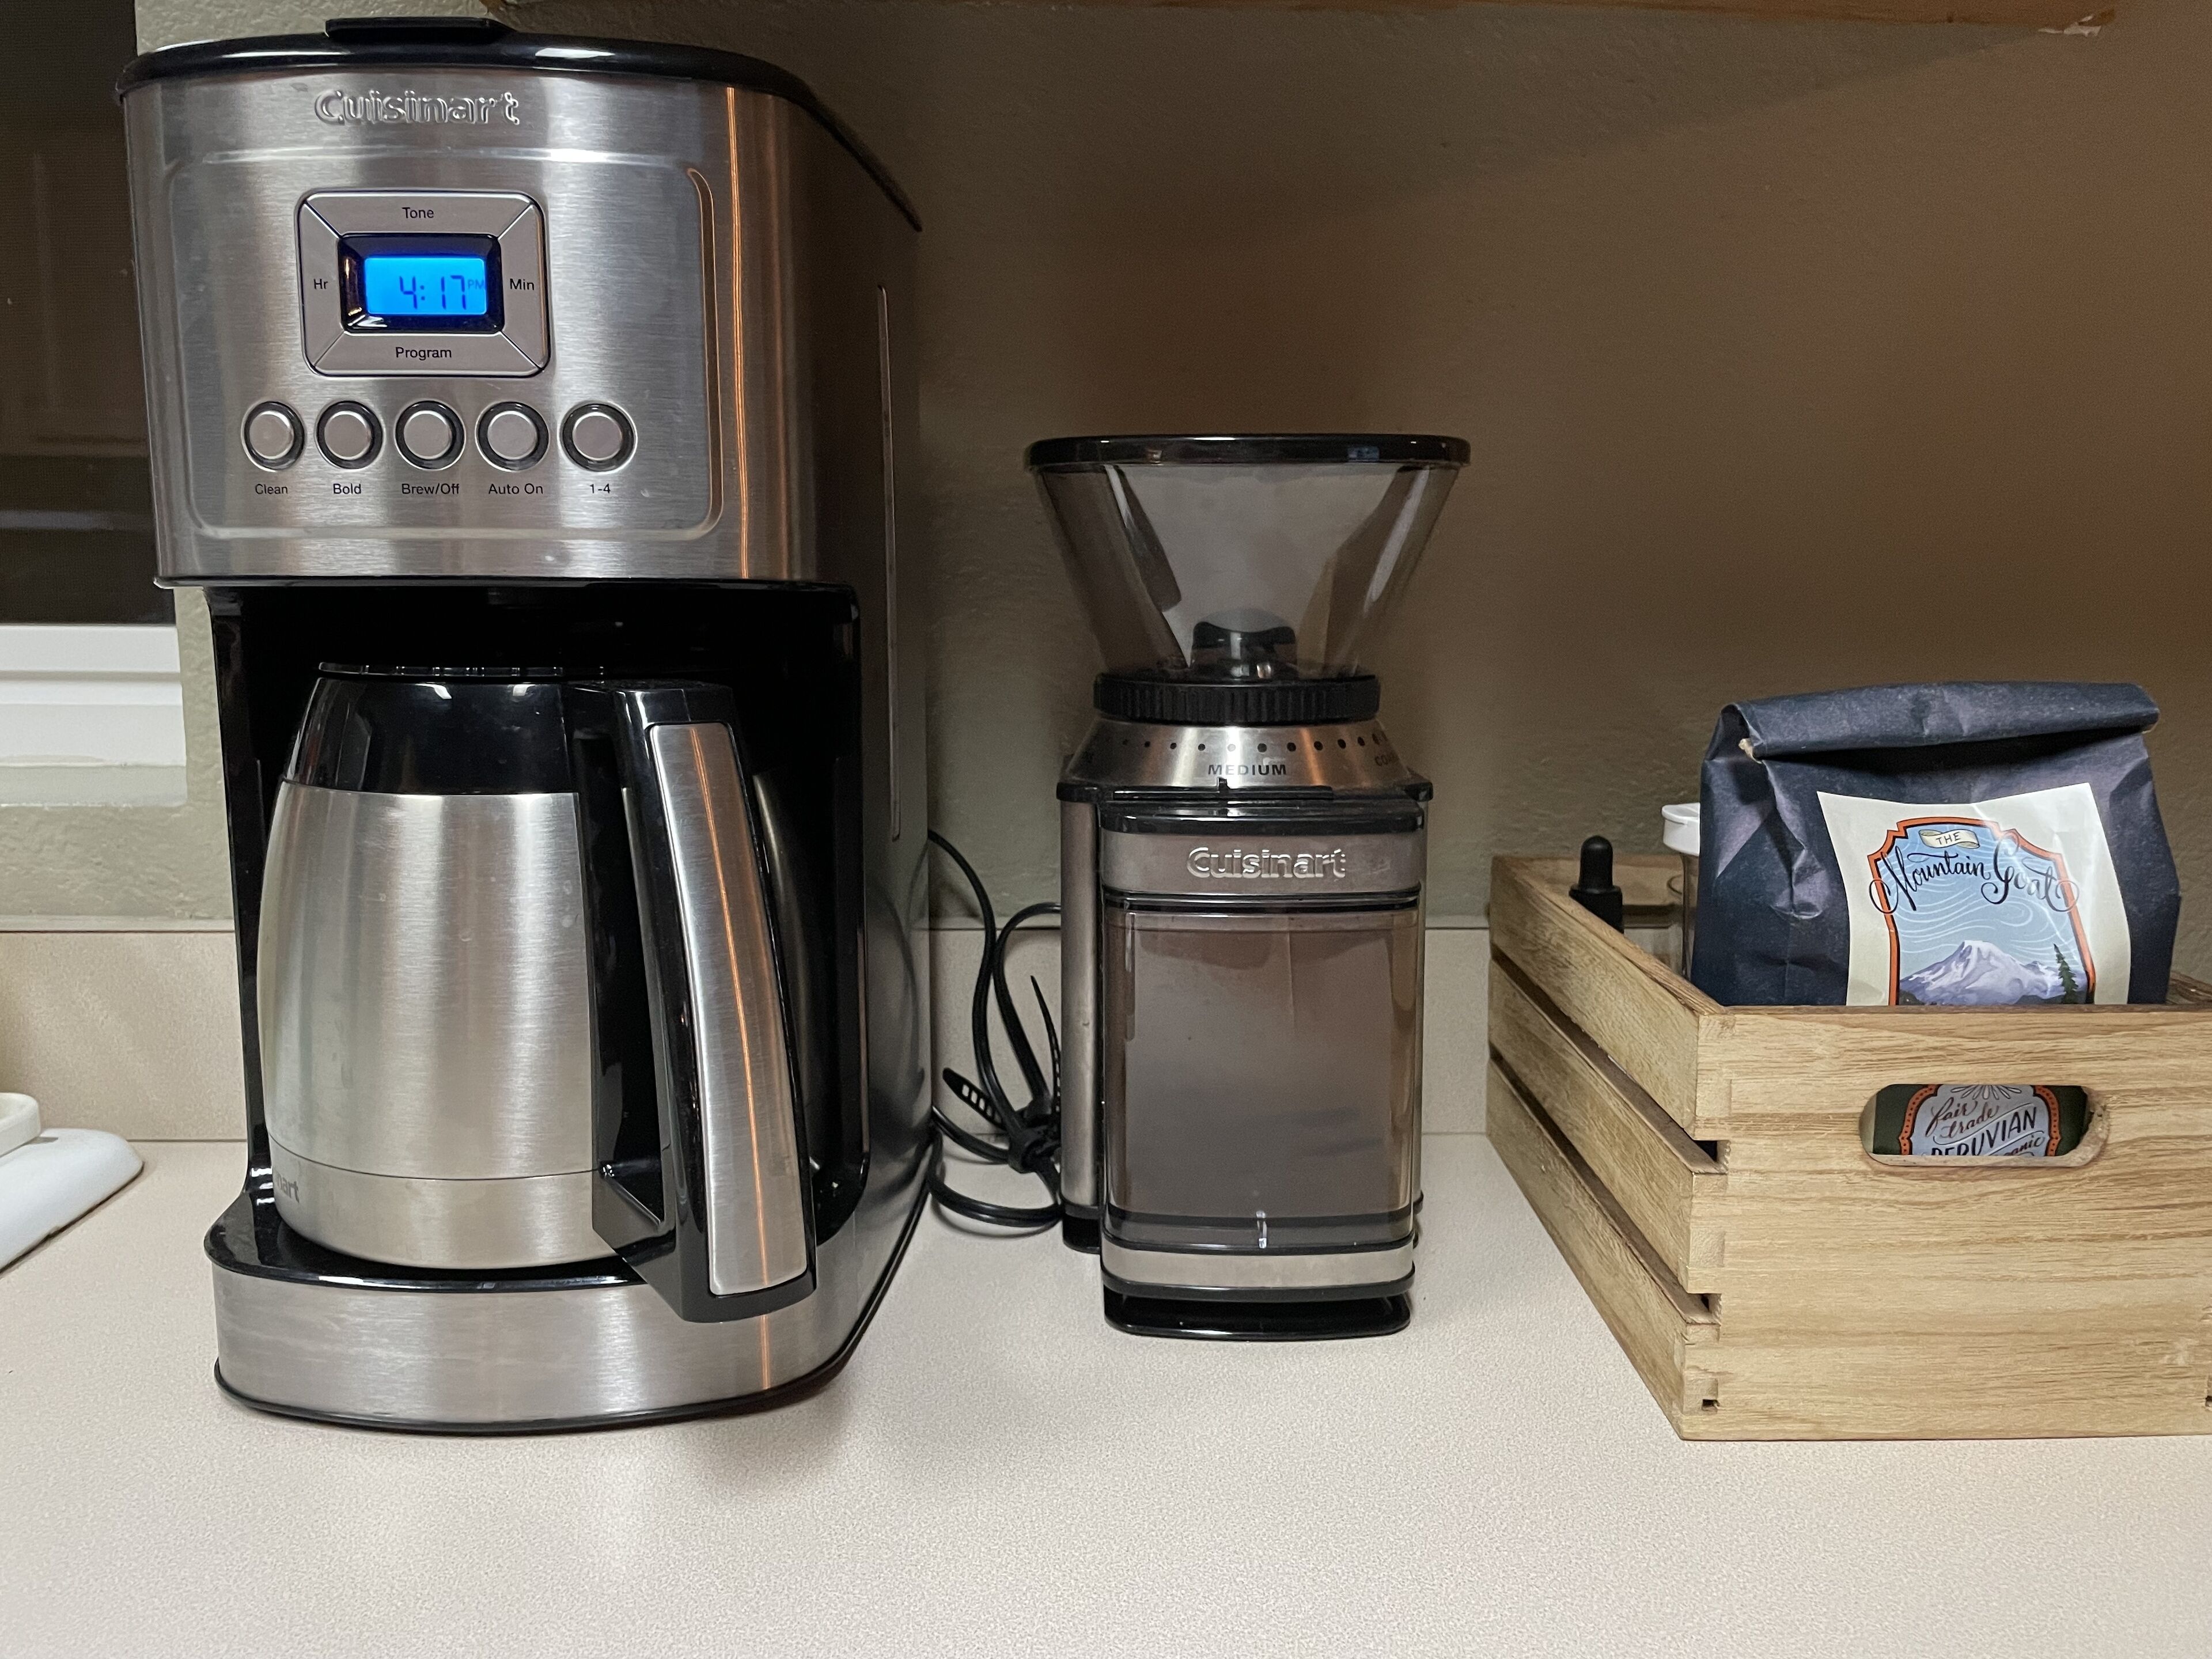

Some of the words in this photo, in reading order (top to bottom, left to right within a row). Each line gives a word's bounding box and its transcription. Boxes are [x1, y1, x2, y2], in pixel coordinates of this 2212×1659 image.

[314, 89, 520, 125] Cuisinart
[402, 207, 435, 219] Tone
[313, 279, 329, 290] Hr
[509, 279, 535, 291] Min
[399, 275, 467, 310] 4:17
[395, 347, 452, 361] Program
[255, 483, 289, 495] Clean
[332, 483, 362, 495] Bold
[402, 483, 460, 495] Brew/Off
[488, 483, 520, 495] Auto
[524, 483, 544, 495] On
[589, 483, 611, 494] 1-4
[1207, 764, 1287, 776] MEDIUM
[1935, 831, 1961, 845] THE
[1187, 847, 1346, 878] Cuisinart
[1869, 846, 1991, 914] Mountain
[1980, 834, 2080, 913] Goat
[1940, 1101, 1999, 1138] trade
